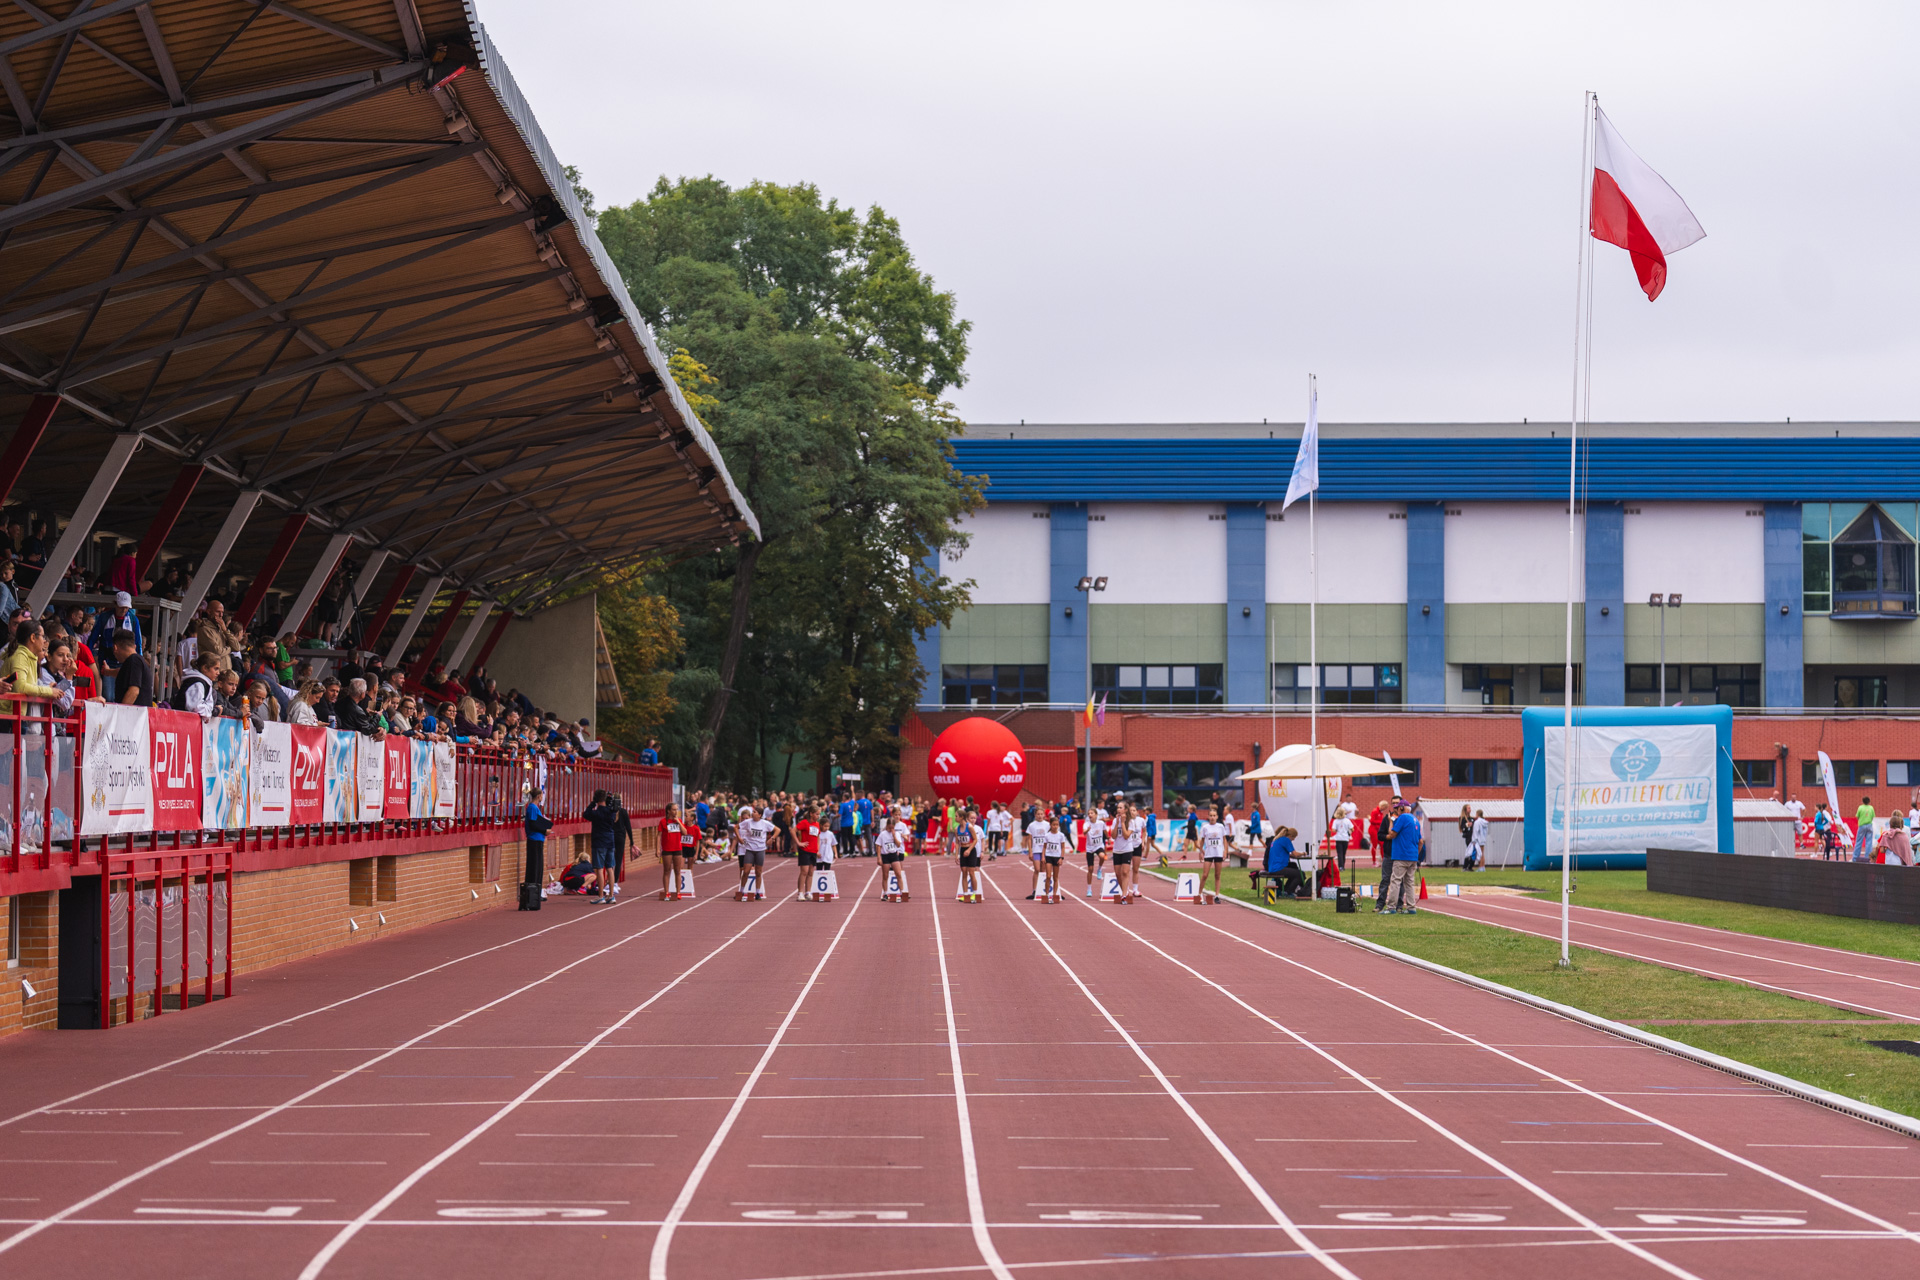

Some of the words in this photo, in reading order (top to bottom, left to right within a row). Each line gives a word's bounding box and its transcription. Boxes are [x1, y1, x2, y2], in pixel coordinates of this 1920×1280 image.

[155, 731, 195, 789] PZLA
[933, 775, 960, 784] ORLEN
[999, 774, 1023, 784] ORLEN
[1563, 782, 1704, 806] EKKOATLETYCZNE
[1622, 810, 1700, 822] OLIMPIJSKIE
[748, 876, 756, 891] 7
[817, 876, 828, 891] 6
[890, 876, 900, 891] 5
[1109, 878, 1120, 894] 2
[1185, 879, 1193, 894] 1
